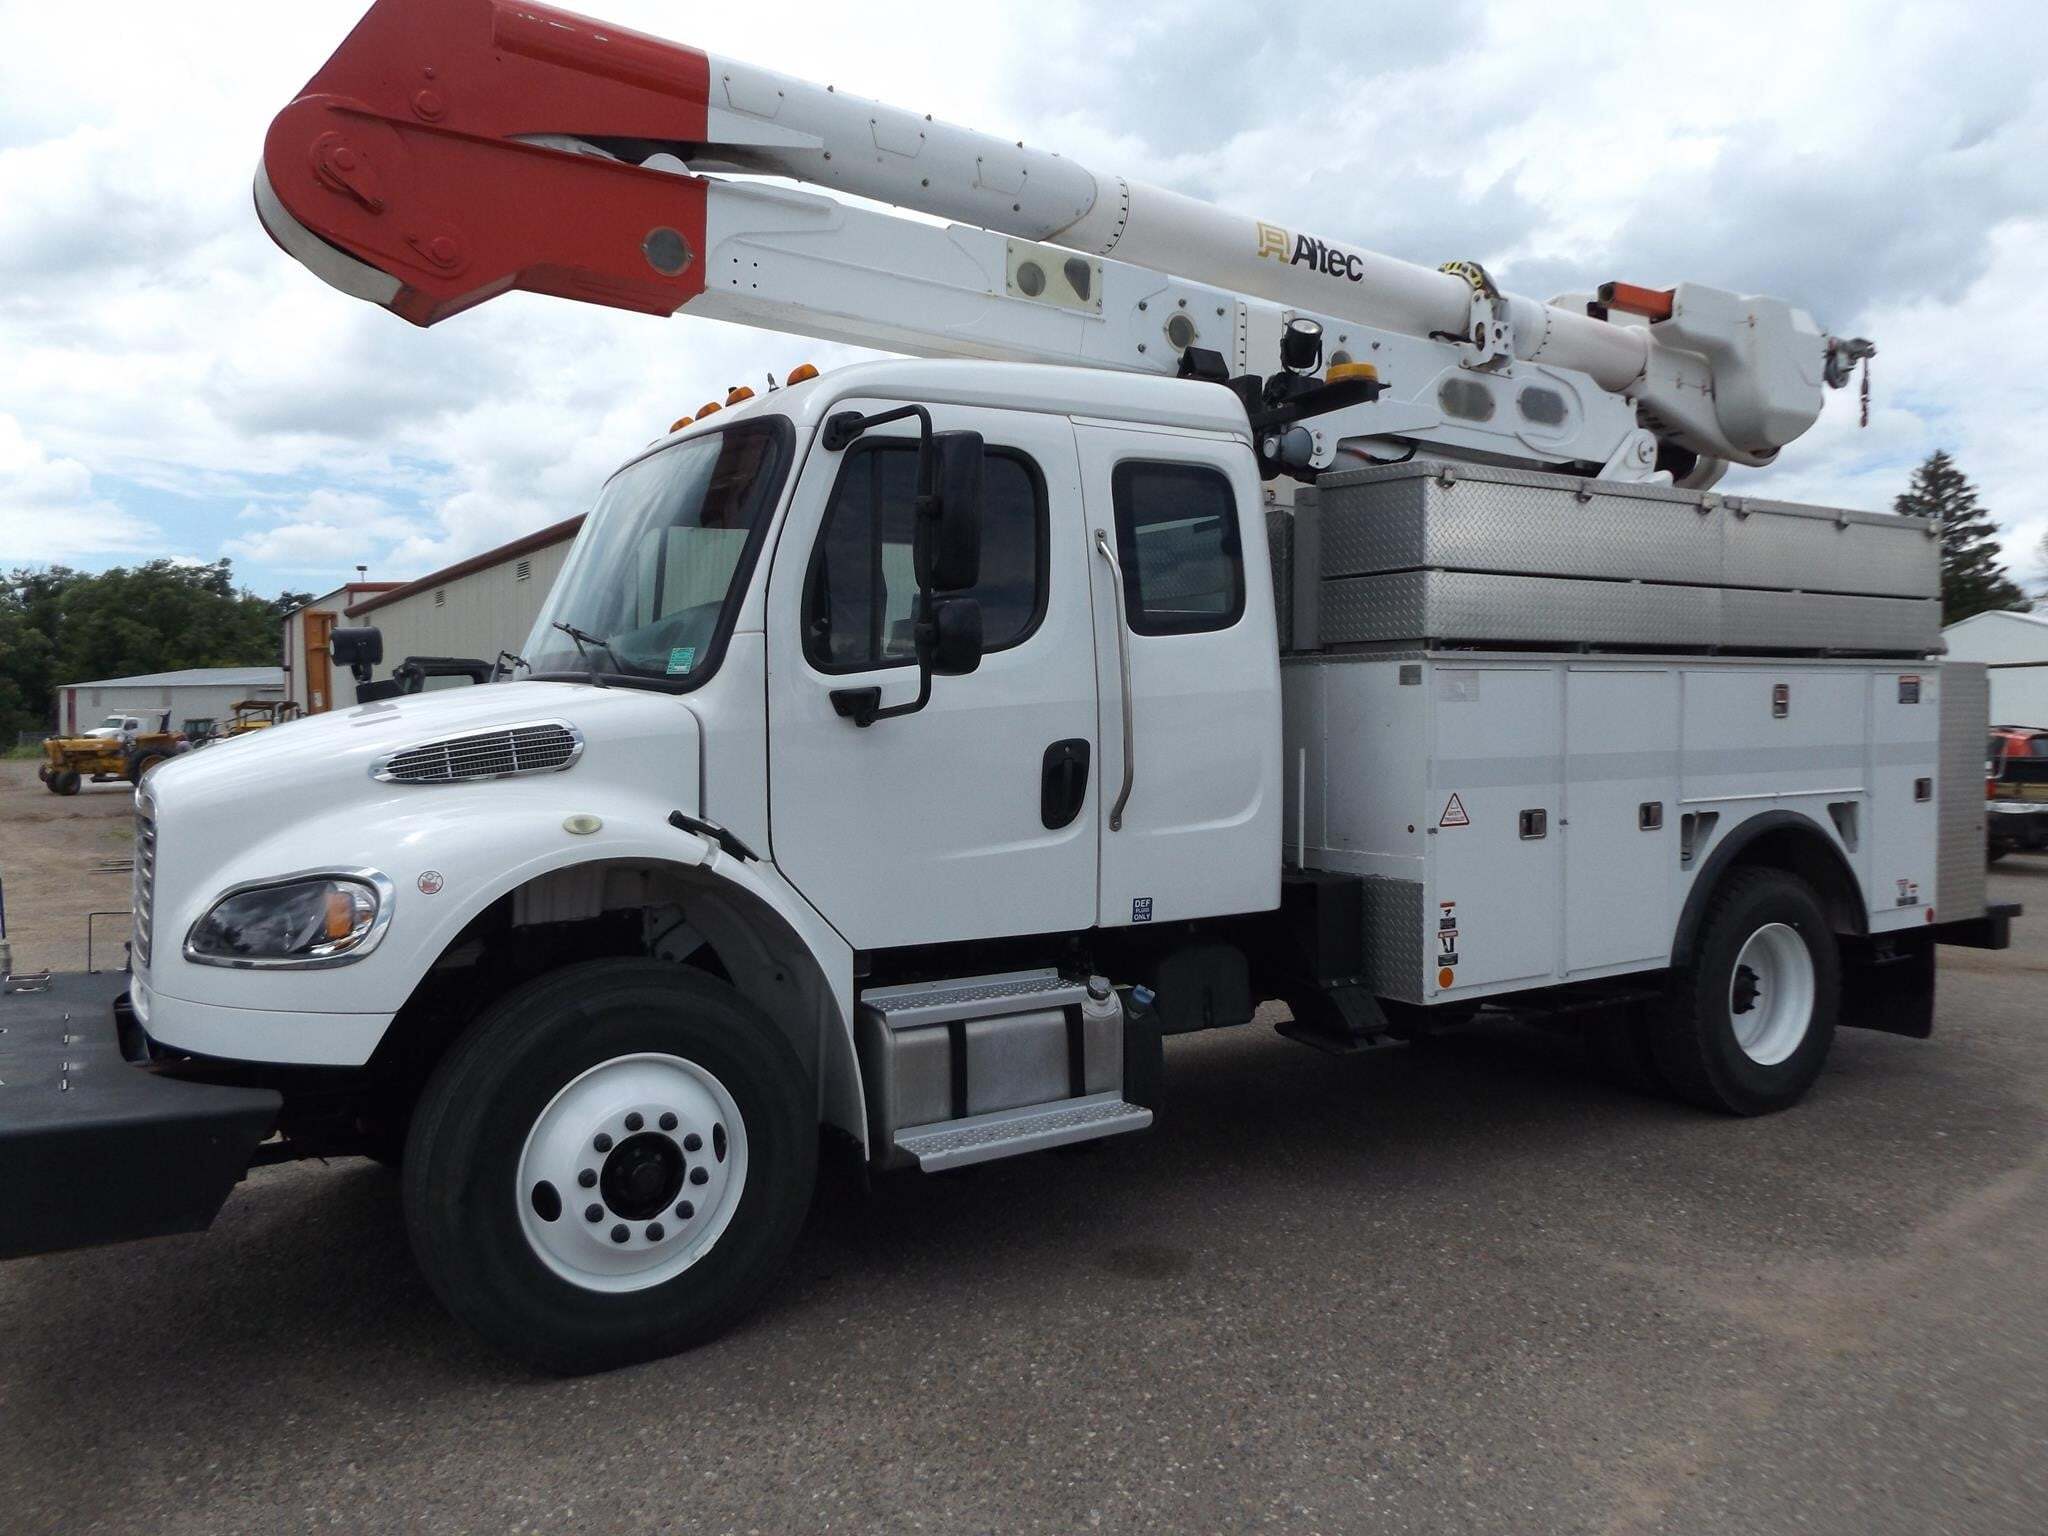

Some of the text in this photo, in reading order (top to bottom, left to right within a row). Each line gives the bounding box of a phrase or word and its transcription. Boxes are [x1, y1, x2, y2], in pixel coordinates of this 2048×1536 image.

[1290, 233, 1363, 282] Altec
[1134, 899, 1151, 908] DEF
[1133, 913, 1151, 921] ONLY
